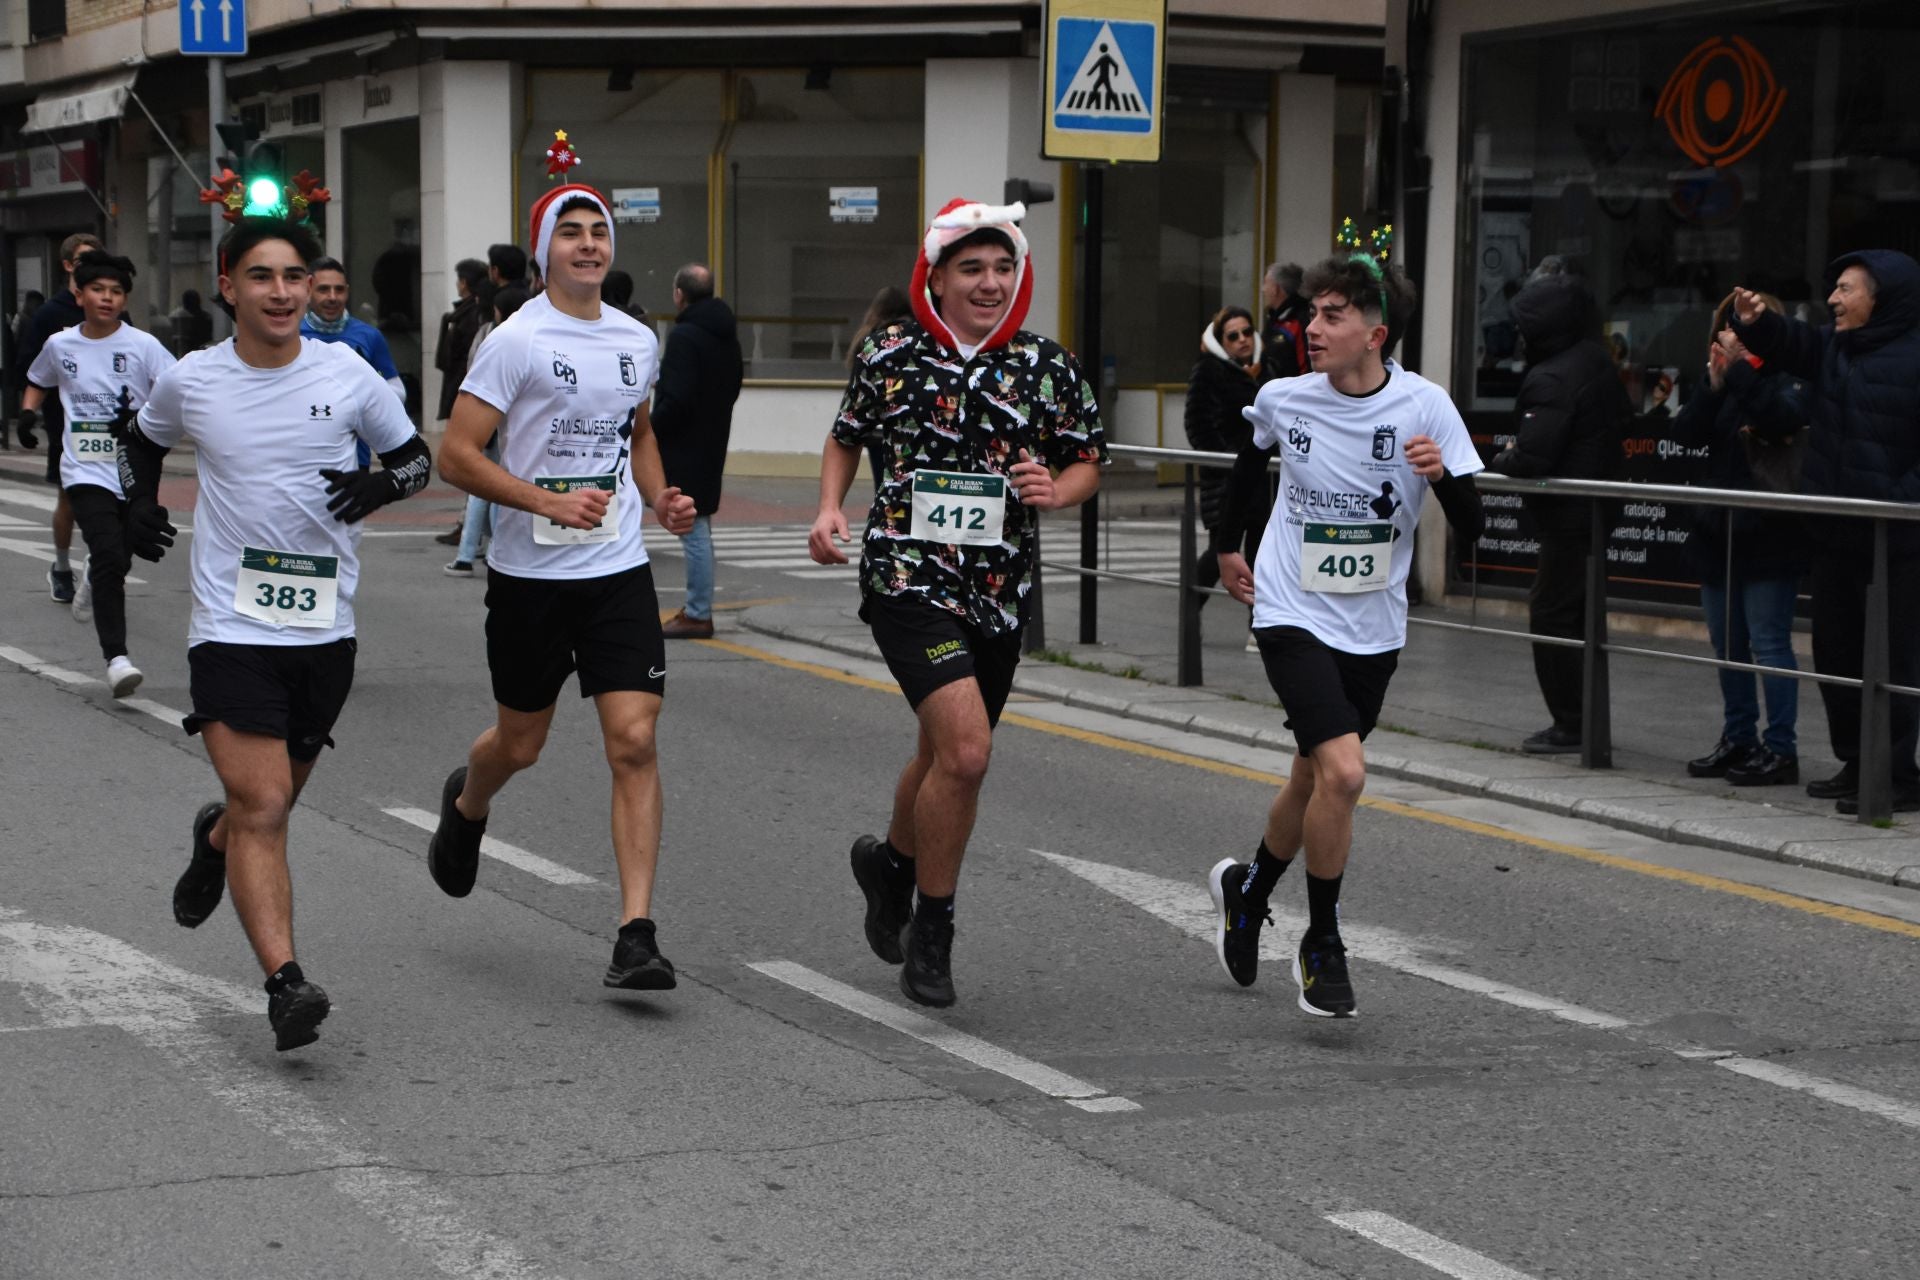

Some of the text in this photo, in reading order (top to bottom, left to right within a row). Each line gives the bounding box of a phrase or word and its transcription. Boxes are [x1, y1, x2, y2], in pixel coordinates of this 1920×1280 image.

[552, 360, 577, 385] CPJ
[550, 418, 618, 436] SAN SILVESTRE
[79, 438, 114, 453] 288
[1288, 427, 1312, 454] CPJ
[1622, 438, 1656, 458] guro
[1288, 485, 1369, 511] SAN SILVESTRE
[928, 504, 986, 530] 412
[1642, 524, 1656, 540] de
[1656, 525, 1666, 541] la
[1666, 528, 1689, 543] mio
[1619, 547, 1648, 563] visual
[1318, 555, 1374, 577] 403
[255, 583, 317, 611] 383
[926, 639, 961, 660] base
